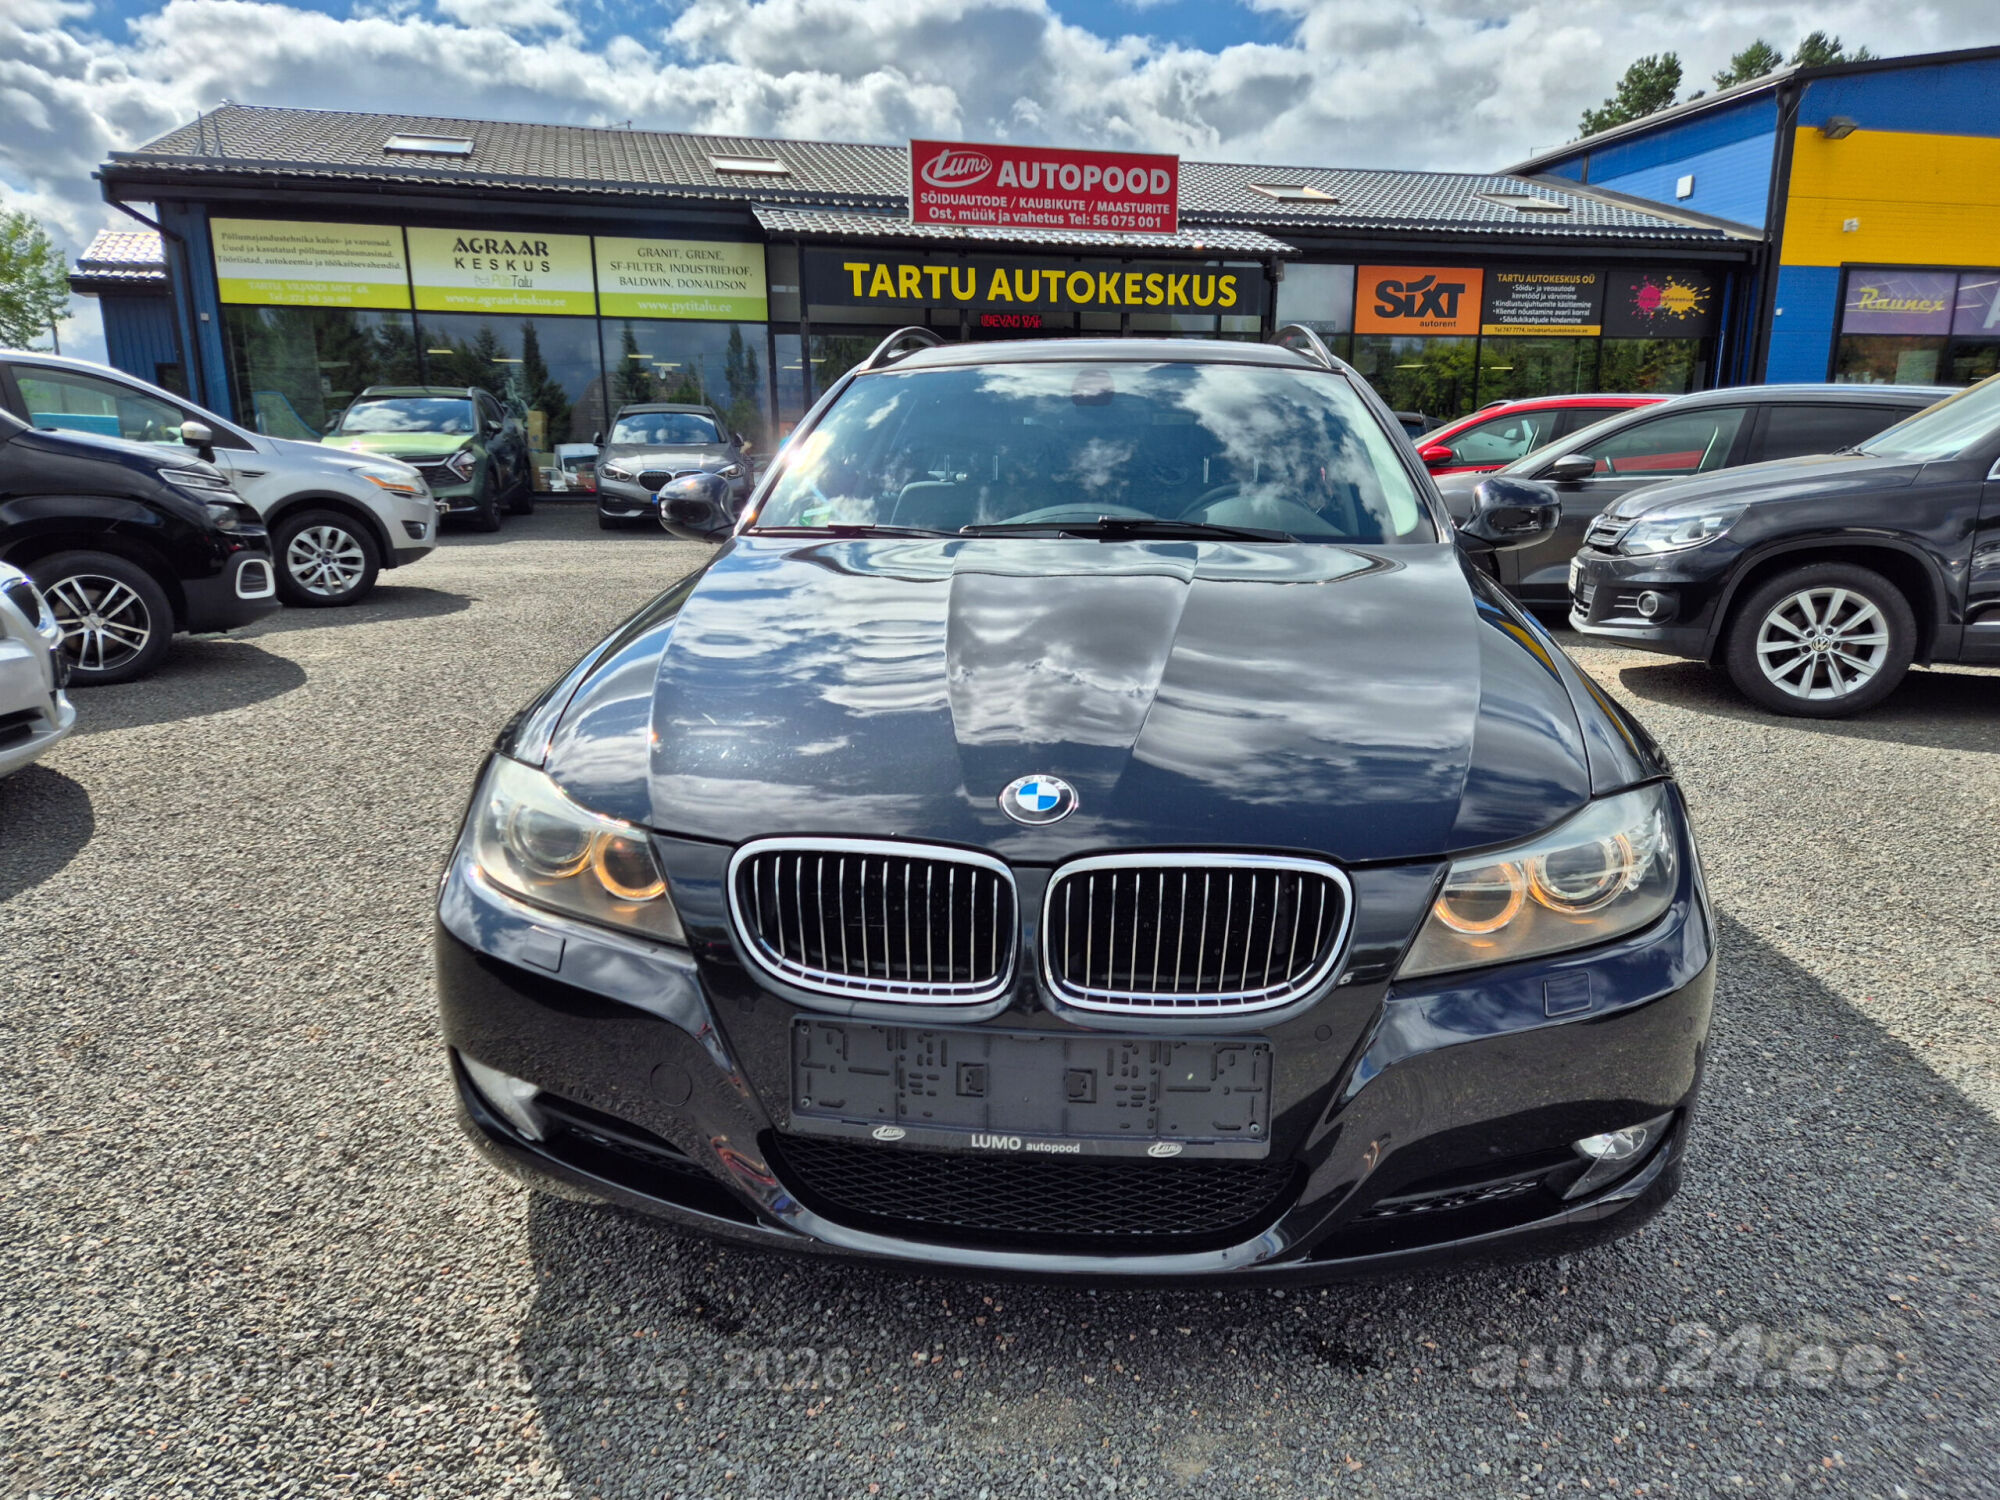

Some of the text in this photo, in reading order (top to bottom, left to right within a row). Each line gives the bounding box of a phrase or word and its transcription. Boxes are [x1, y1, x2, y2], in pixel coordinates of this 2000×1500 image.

[932, 149, 1171, 195] Lumo AUTOPOOD
[920, 190, 1008, 208] SÕIDUAUTODE
[1019, 197, 1086, 211] KAUBIKUTE
[1097, 201, 1171, 215] MAASTURITE
[929, 207, 1162, 229] Ost, müük ja vahetus Tel: 56 075 001
[246, 244, 254, 254] ja
[345, 236, 352, 247] ja
[452, 237, 550, 257] AGRAAR
[637, 247, 725, 262] GRANIT, GRENE,
[314, 258, 323, 268] ja
[454, 256, 551, 273] KESKUS
[610, 261, 753, 277] SF-FILTER, INDUSTRIEHOF,
[619, 276, 747, 291] BALDWIN, DONALDSON
[843, 262, 1238, 307] TARTU AUTOKESKUS
[1497, 272, 1596, 284] TARTU AUTOKESKUS OÜ
[445, 293, 567, 308] www.agraarkeskus.ee
[637, 300, 732, 316] www.pytitalu.ee
[1419, 320, 1457, 328] autorent
[971, 1134, 1022, 1150] LUMO
[1026, 1141, 1080, 1154] autopood
